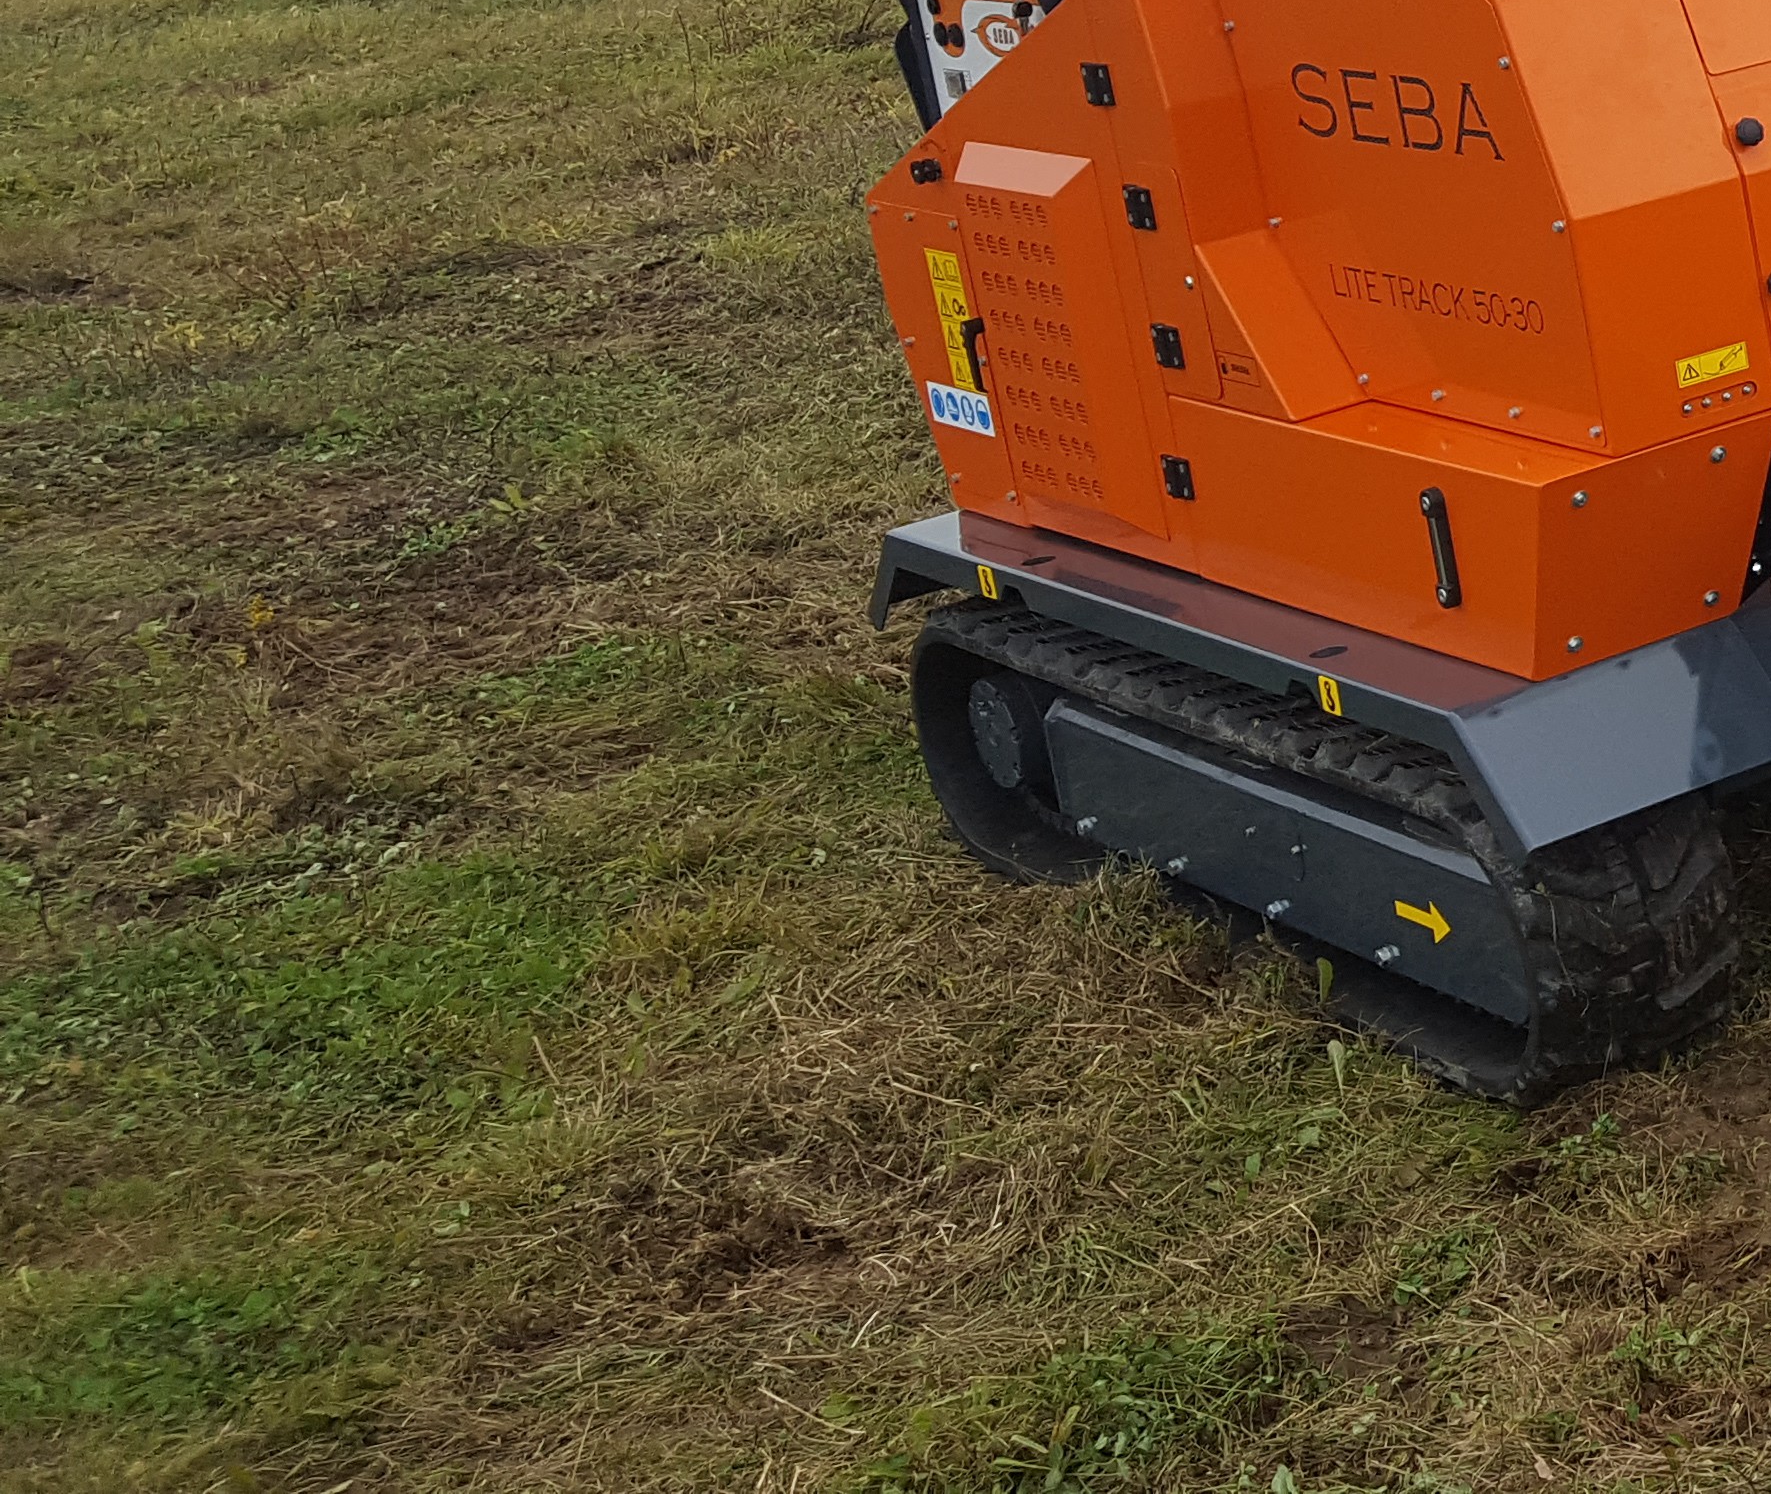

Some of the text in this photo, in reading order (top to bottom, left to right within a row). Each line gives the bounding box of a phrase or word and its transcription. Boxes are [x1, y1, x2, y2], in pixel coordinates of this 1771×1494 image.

[1291, 62, 1506, 162] SEBA
[1329, 263, 1545, 335] LITE TRACK 50-30
